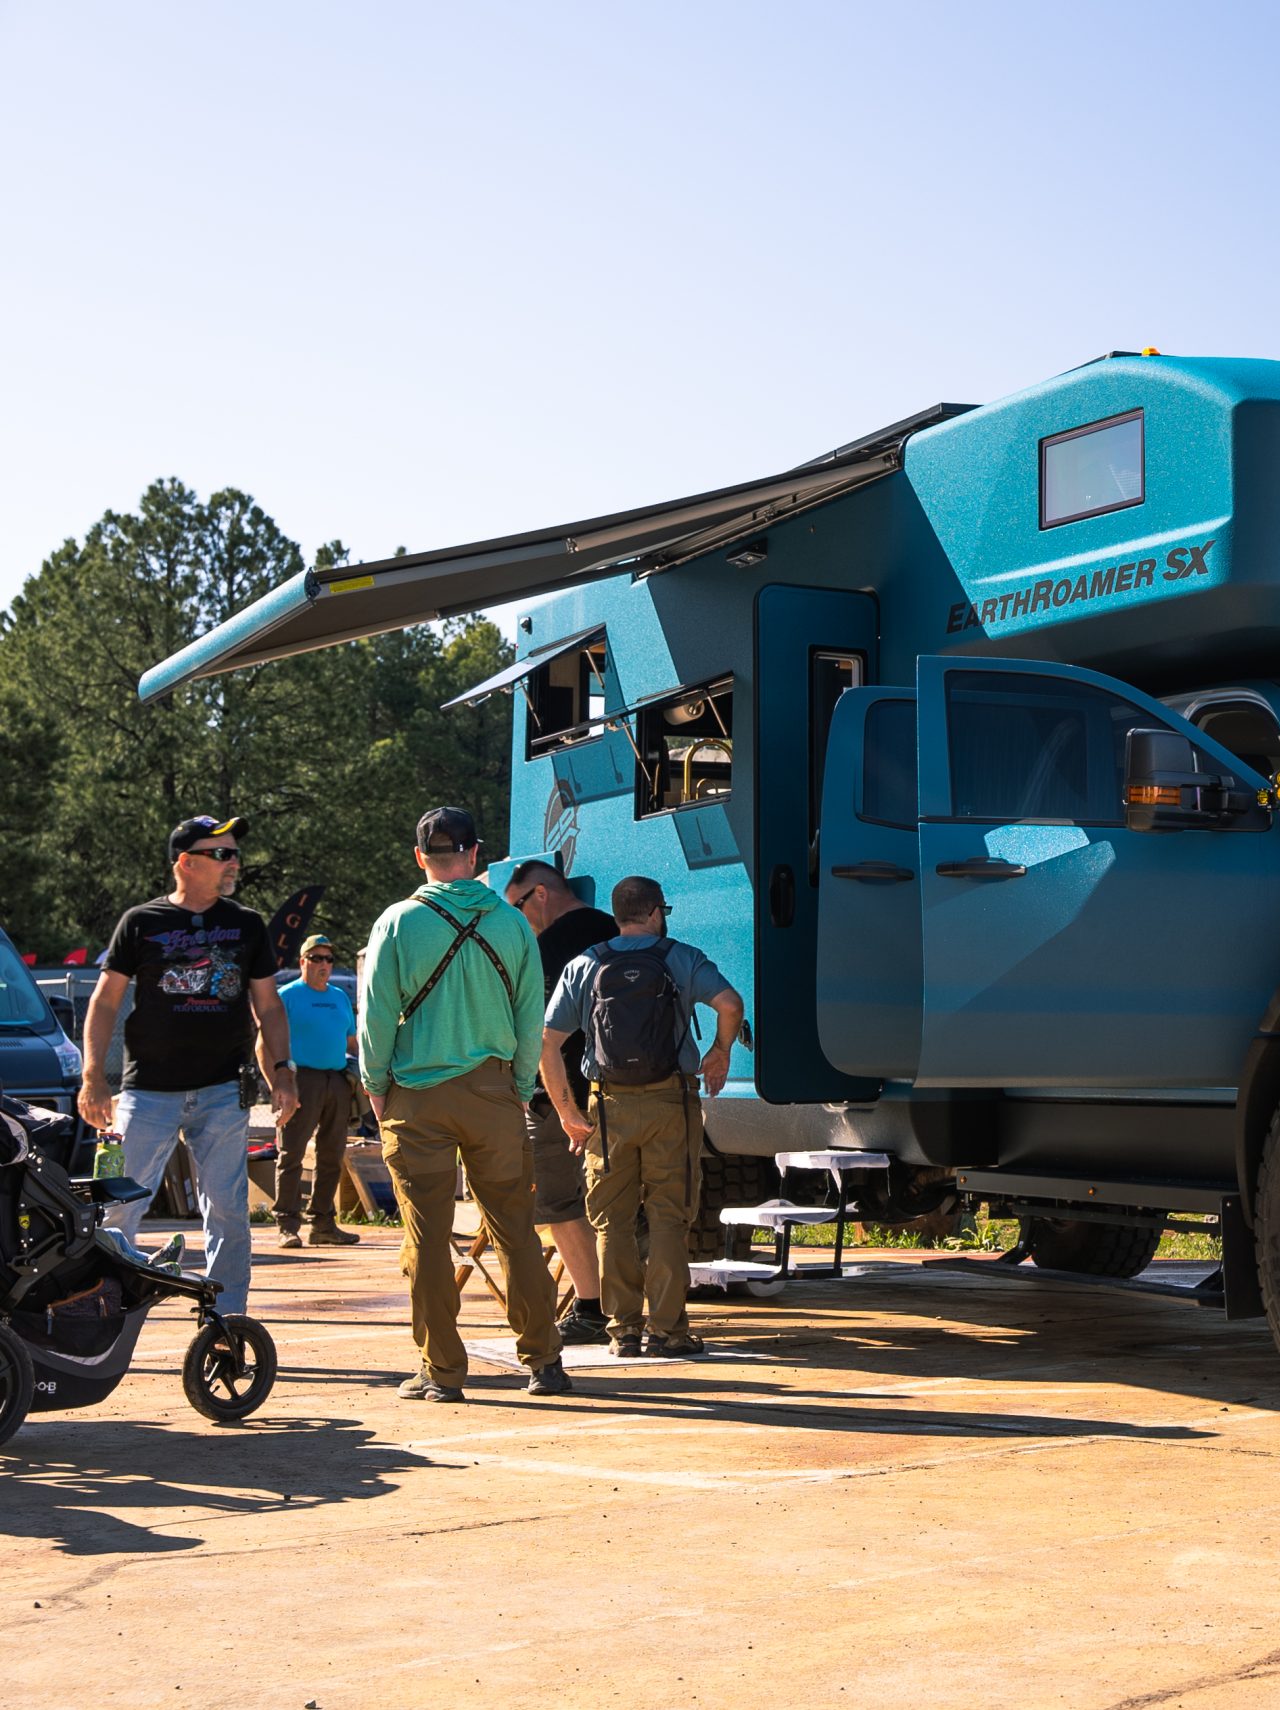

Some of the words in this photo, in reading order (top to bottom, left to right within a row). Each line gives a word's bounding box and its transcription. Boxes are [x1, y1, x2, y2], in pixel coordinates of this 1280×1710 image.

[946, 558, 1157, 634] EARTHROAMER
[1162, 540, 1216, 581] SX
[163, 926, 242, 953] Freedom
